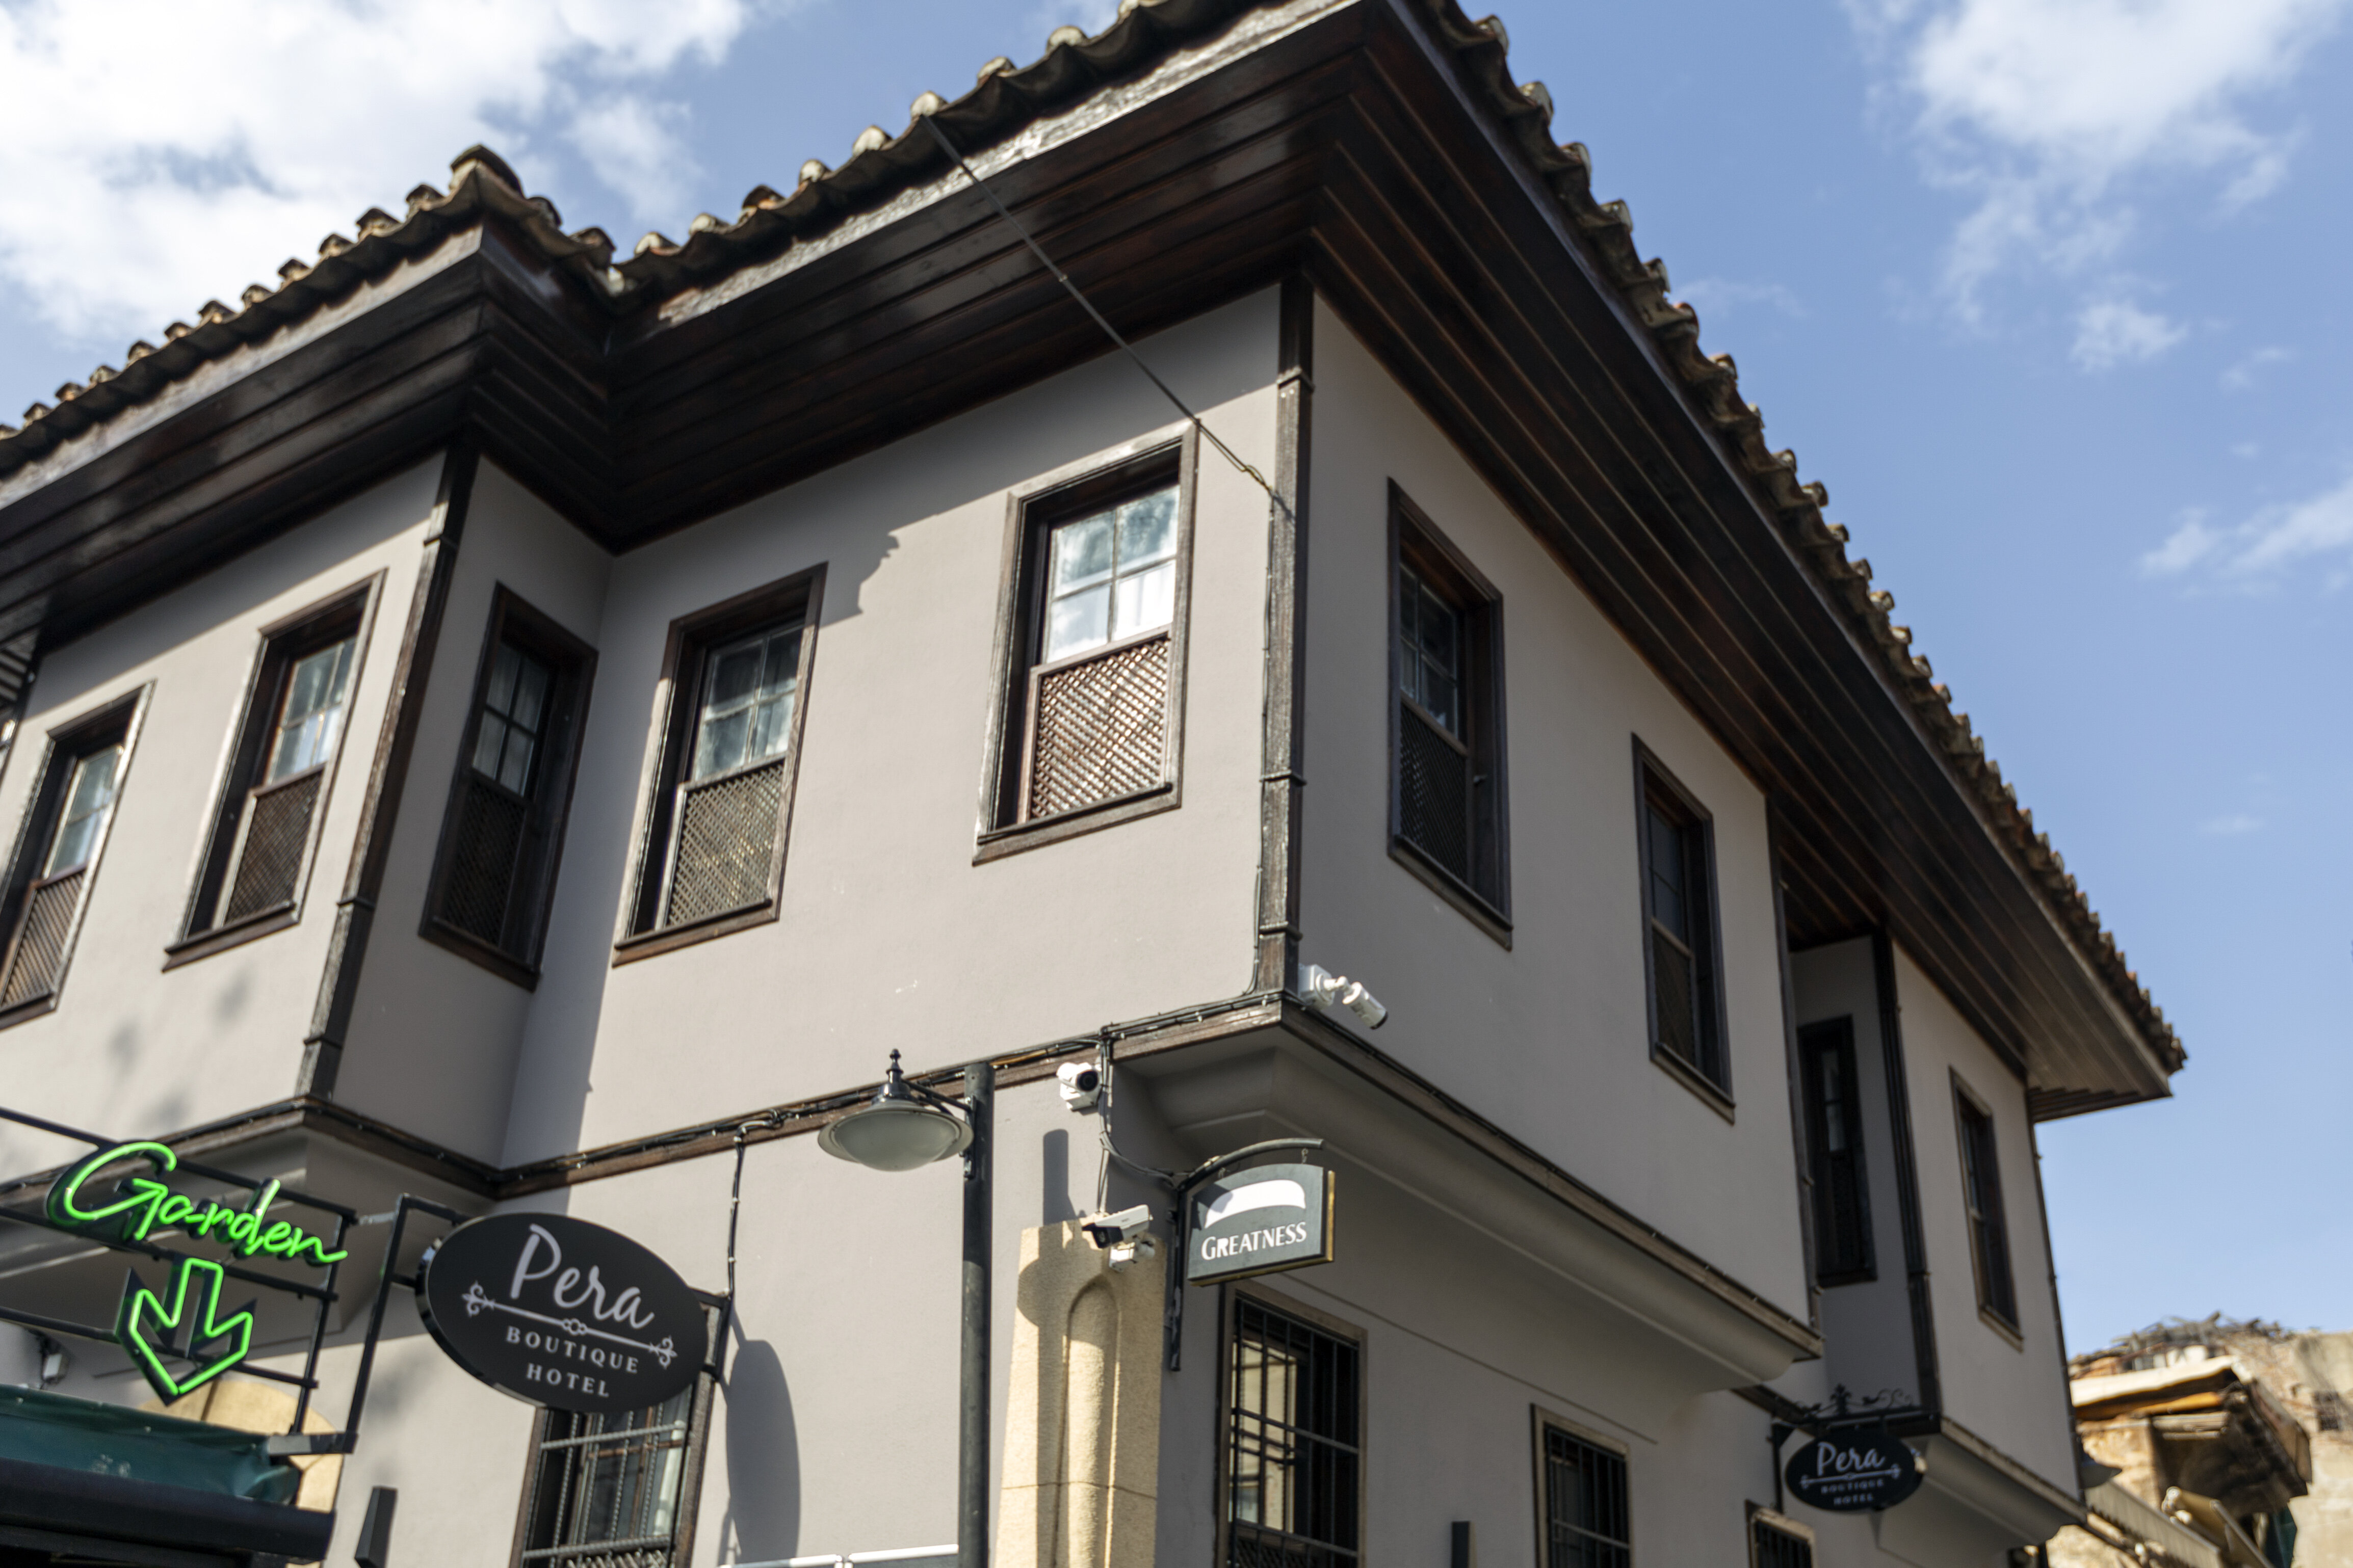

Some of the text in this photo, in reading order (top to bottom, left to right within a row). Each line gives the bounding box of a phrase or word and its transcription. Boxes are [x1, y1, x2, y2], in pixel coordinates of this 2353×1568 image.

[64, 1141, 348, 1263] Garden
[1201, 1221, 1307, 1260] GREATNESS
[511, 1224, 655, 1328] Pera
[506, 1326, 639, 1374] BOUTIQUE
[527, 1363, 609, 1397] HOTEL
[1817, 1442, 1886, 1476] Pera
[1834, 1493, 1873, 1505] HOTEL
